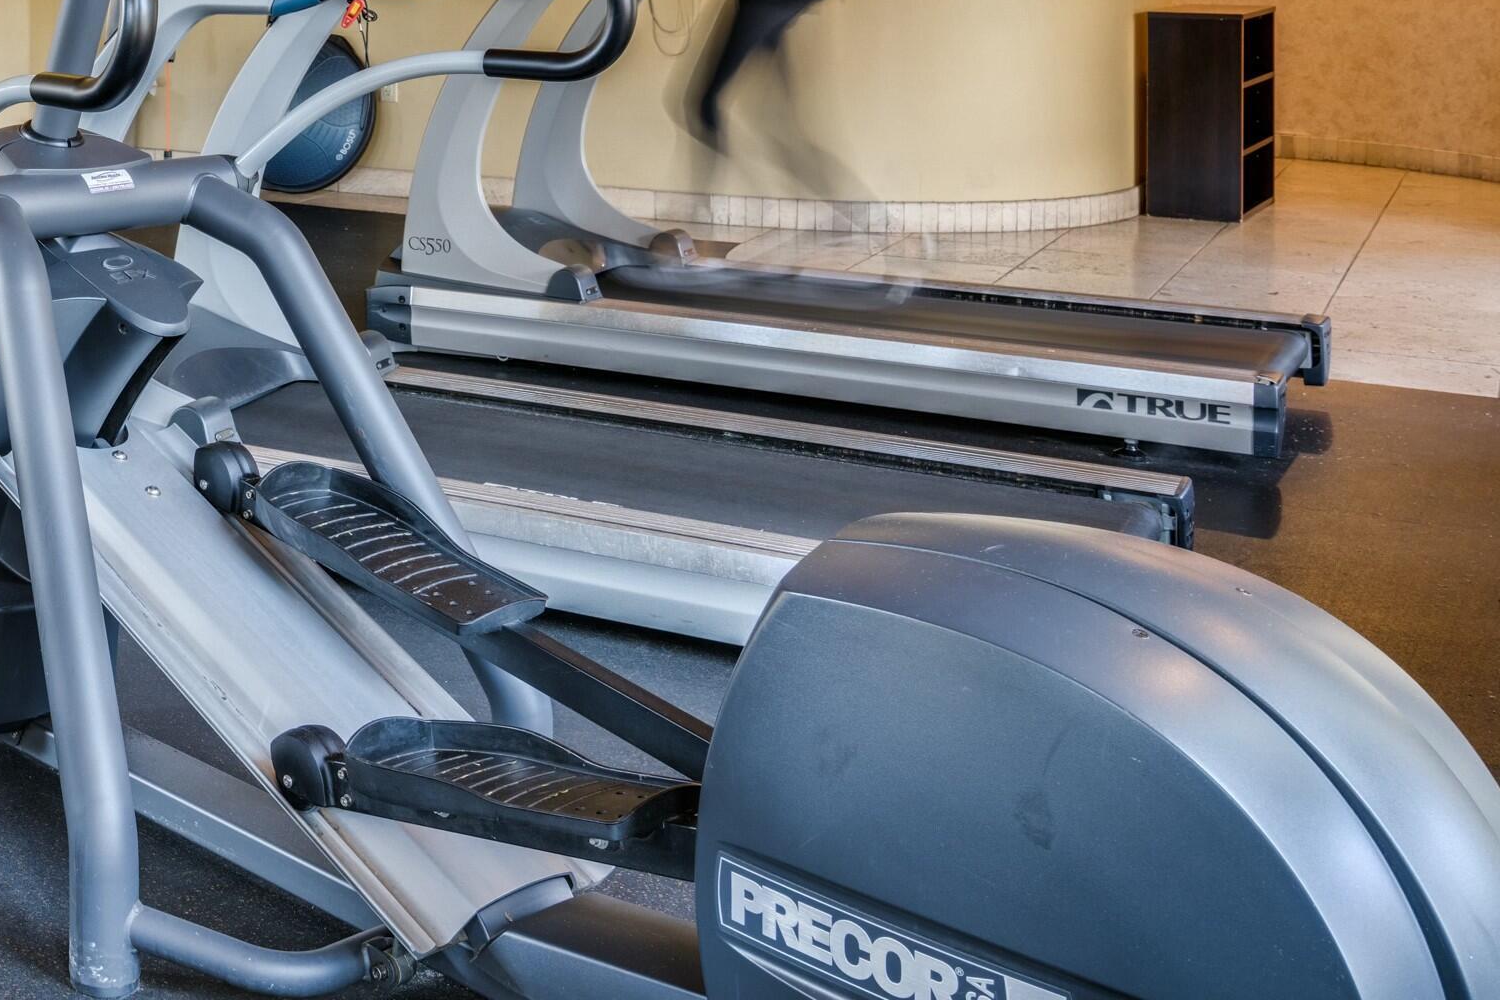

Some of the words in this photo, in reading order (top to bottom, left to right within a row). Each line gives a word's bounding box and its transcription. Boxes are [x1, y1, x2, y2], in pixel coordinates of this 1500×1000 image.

[339, 128, 356, 155] BOSU
[408, 236, 451, 256] CS550
[1117, 392, 1231, 425] TRUE
